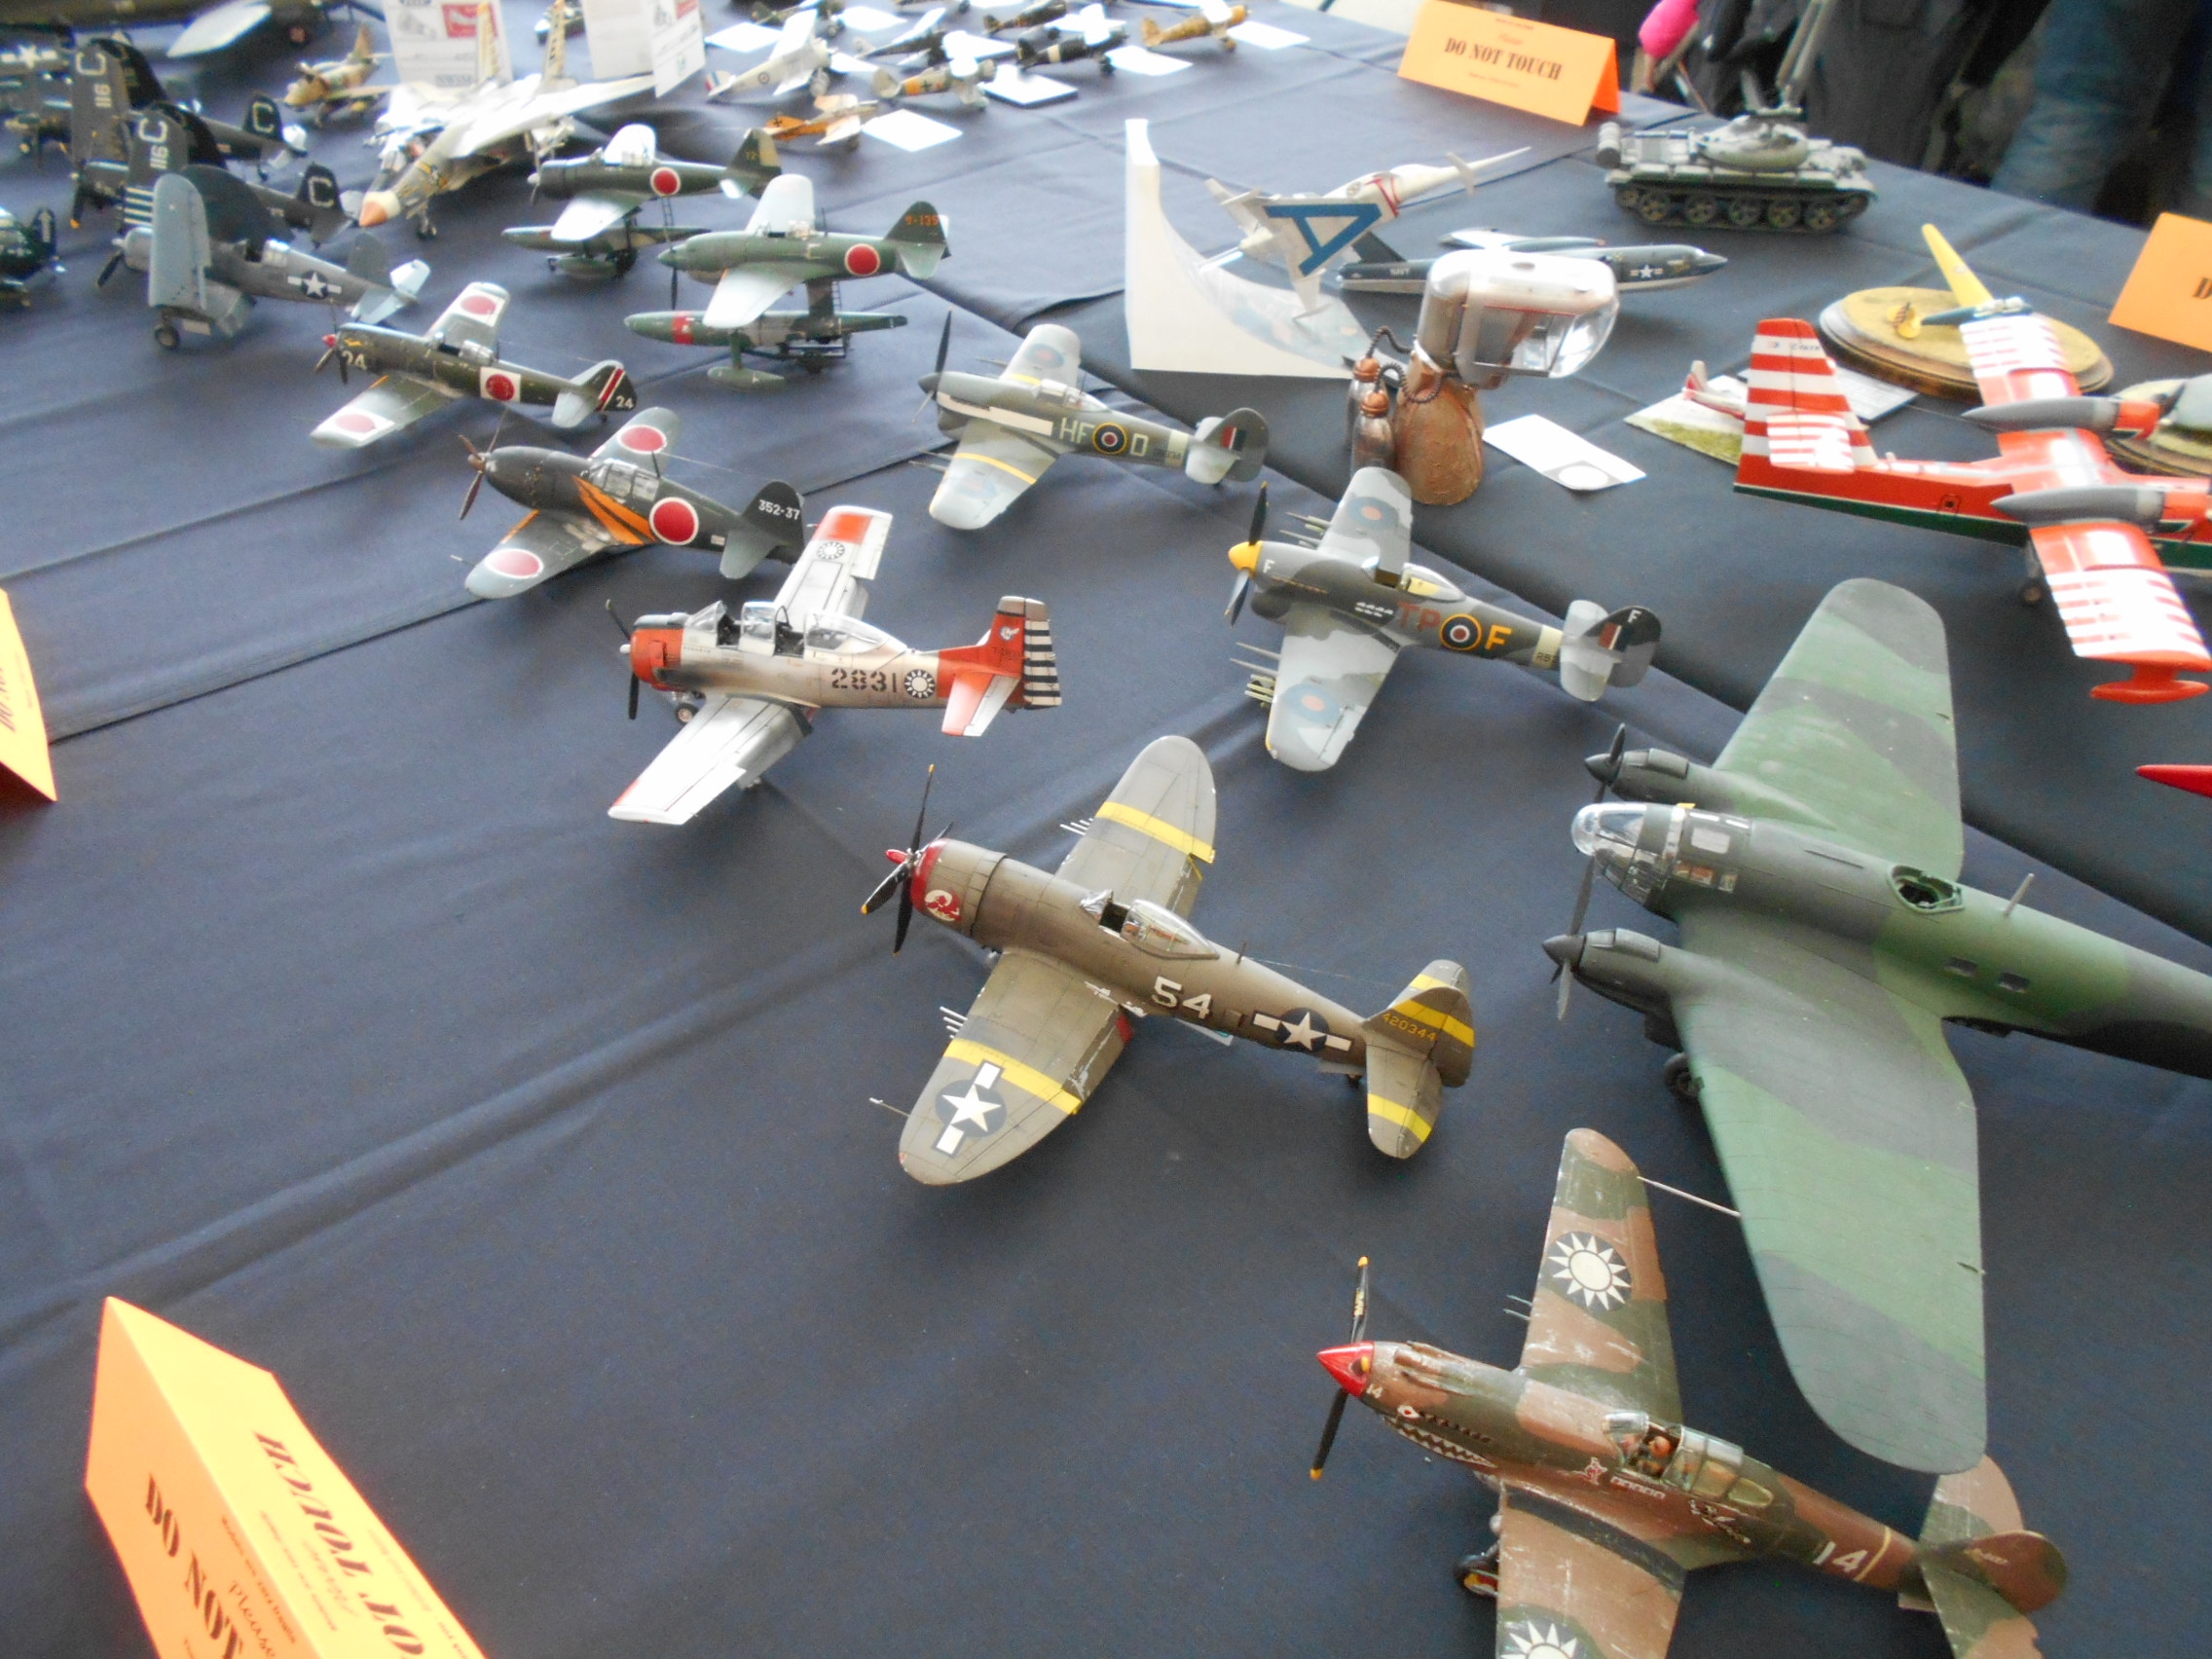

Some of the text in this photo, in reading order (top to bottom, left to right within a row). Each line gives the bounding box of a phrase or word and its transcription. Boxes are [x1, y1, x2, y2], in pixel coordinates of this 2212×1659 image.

[76, 52, 107, 76] C
[1444, 37, 1468, 56] DO
[1469, 43, 1503, 66] NOT
[1508, 52, 1564, 81] TOUCH
[138, 117, 168, 143] C
[253, 101, 275, 133] C
[308, 176, 335, 208] C
[615, 395, 635, 409] 24
[1059, 417, 1095, 444] HF
[757, 498, 801, 521] 352-37
[1263, 559, 1276, 573] F
[1397, 601, 1513, 650] TP F
[1627, 608, 1641, 623] F
[830, 667, 898, 694] 2831
[1151, 976, 1213, 1020] 54
[1382, 1013, 1439, 1042] 420344
[1365, 1382, 1384, 1399] 14
[144, 1471, 181, 1559] DO
[251, 1428, 375, 1576] TOUCH
[1812, 1540, 1869, 1574] 14
[357, 1590, 424, 1659] OT
